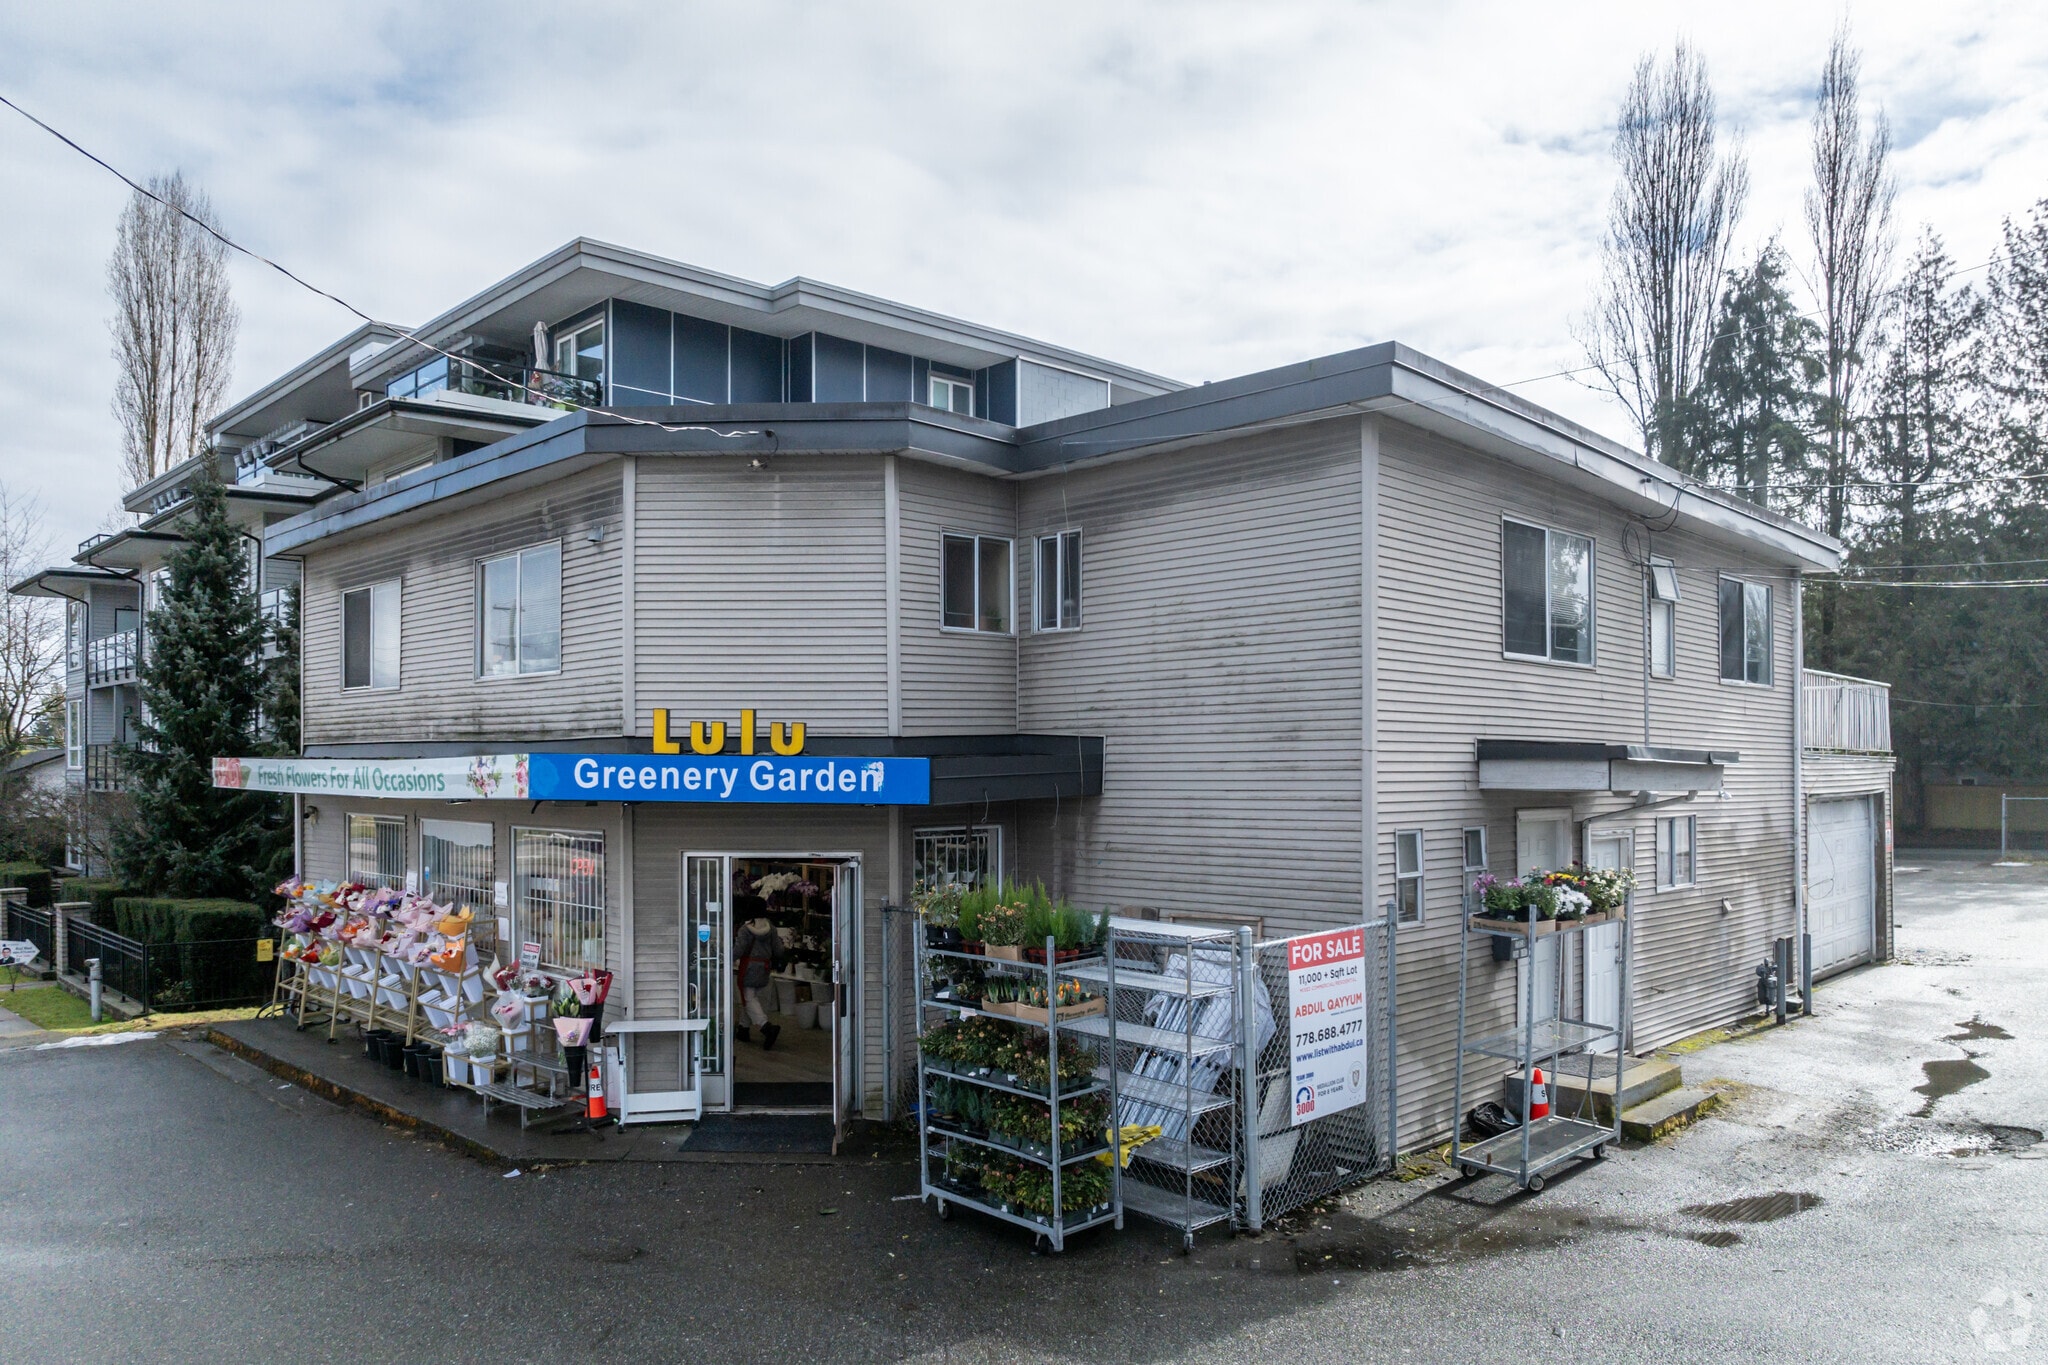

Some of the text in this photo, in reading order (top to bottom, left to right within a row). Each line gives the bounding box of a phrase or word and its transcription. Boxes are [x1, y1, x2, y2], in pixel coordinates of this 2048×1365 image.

[652, 708, 807, 756] Lulu
[258, 765, 445, 792] Fresh Flowers For All Occasions
[574, 757, 883, 799] Greenery Garden
[1292, 935, 1361, 965] FOR SALE
[1299, 971, 1322, 986] 11,000
[1330, 967, 1345, 981] Sqft
[1347, 965, 1358, 976] Lot
[1294, 1001, 1325, 1018] ABDUL
[1327, 992, 1363, 1011] QAYYUM
[1296, 1020, 1363, 1048] 778.688.4777
[1296, 1038, 1364, 1062] www.listwithabdul.ca
[1296, 1099, 1315, 1116] 3000
